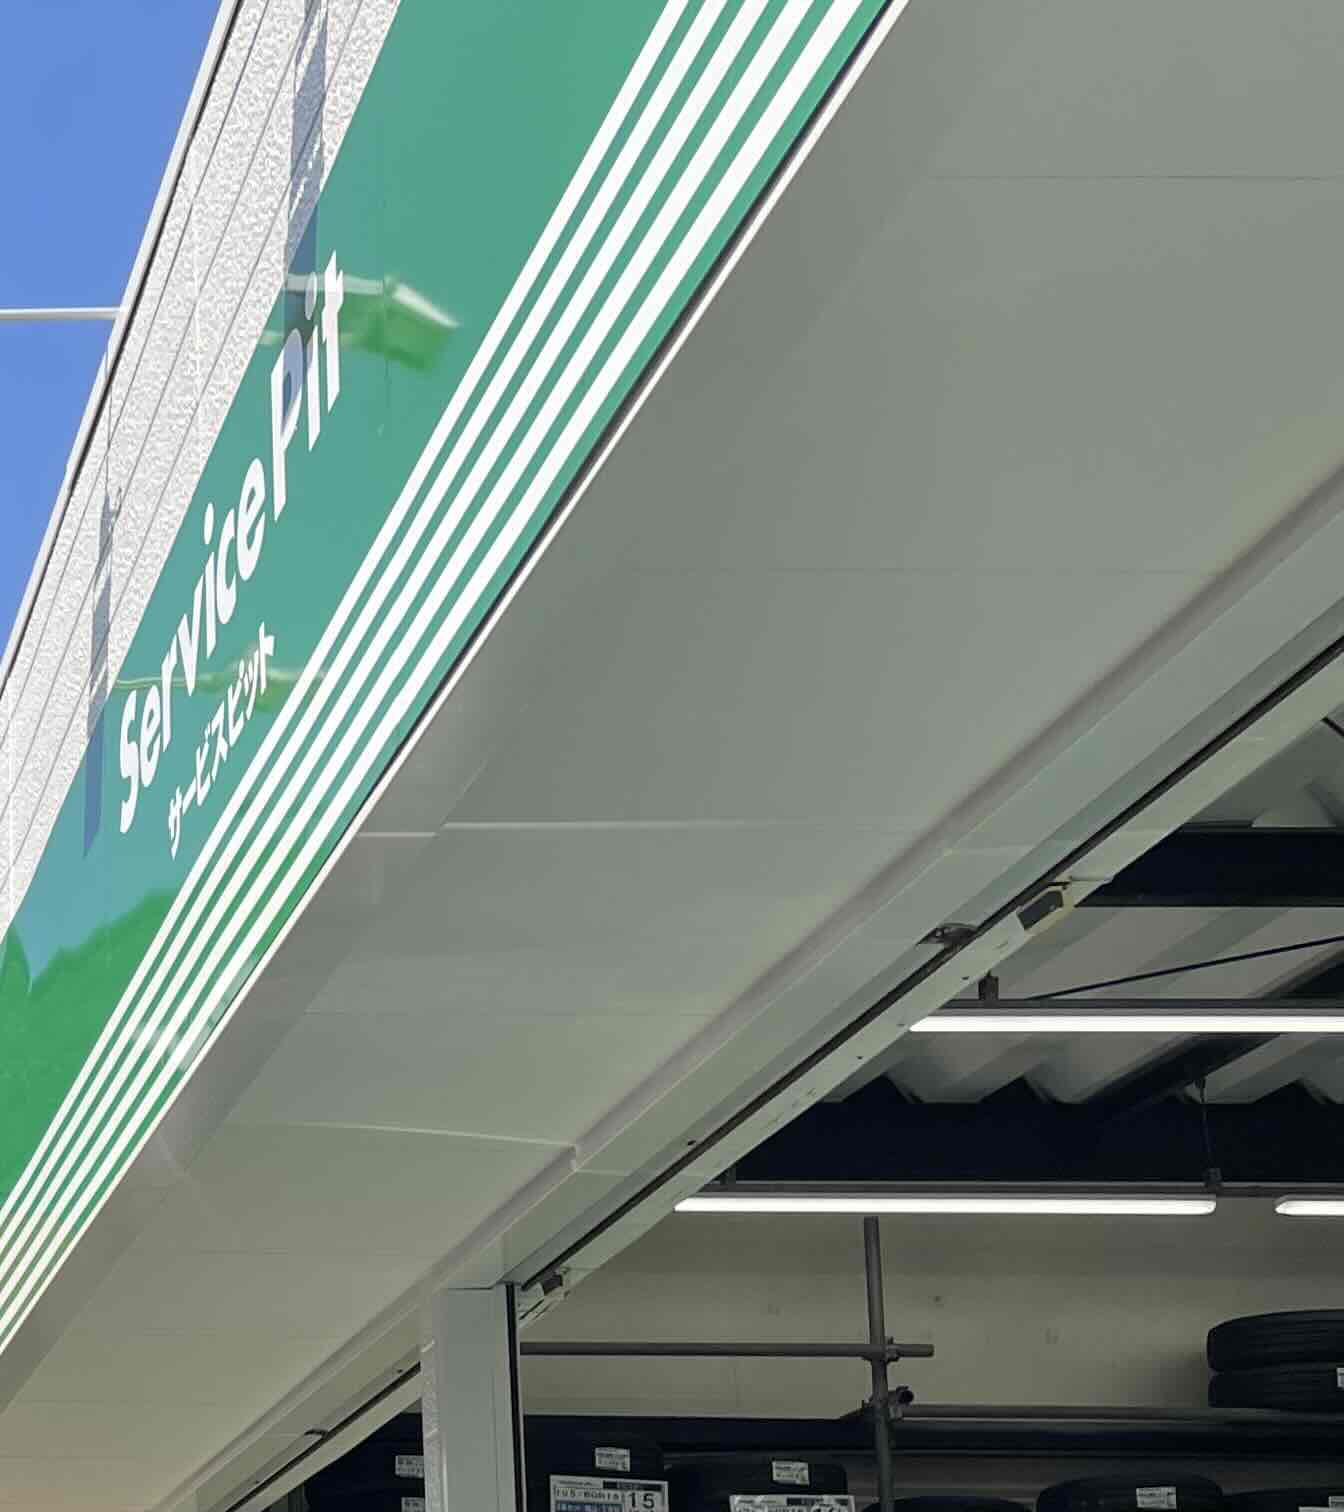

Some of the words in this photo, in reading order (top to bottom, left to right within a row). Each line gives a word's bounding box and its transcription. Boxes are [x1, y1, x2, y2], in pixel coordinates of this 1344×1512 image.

[118, 458, 267, 834] Service
[270, 249, 344, 522] Pit
[167, 621, 275, 860] サービスピット
[629, 1492, 655, 1509] 15
